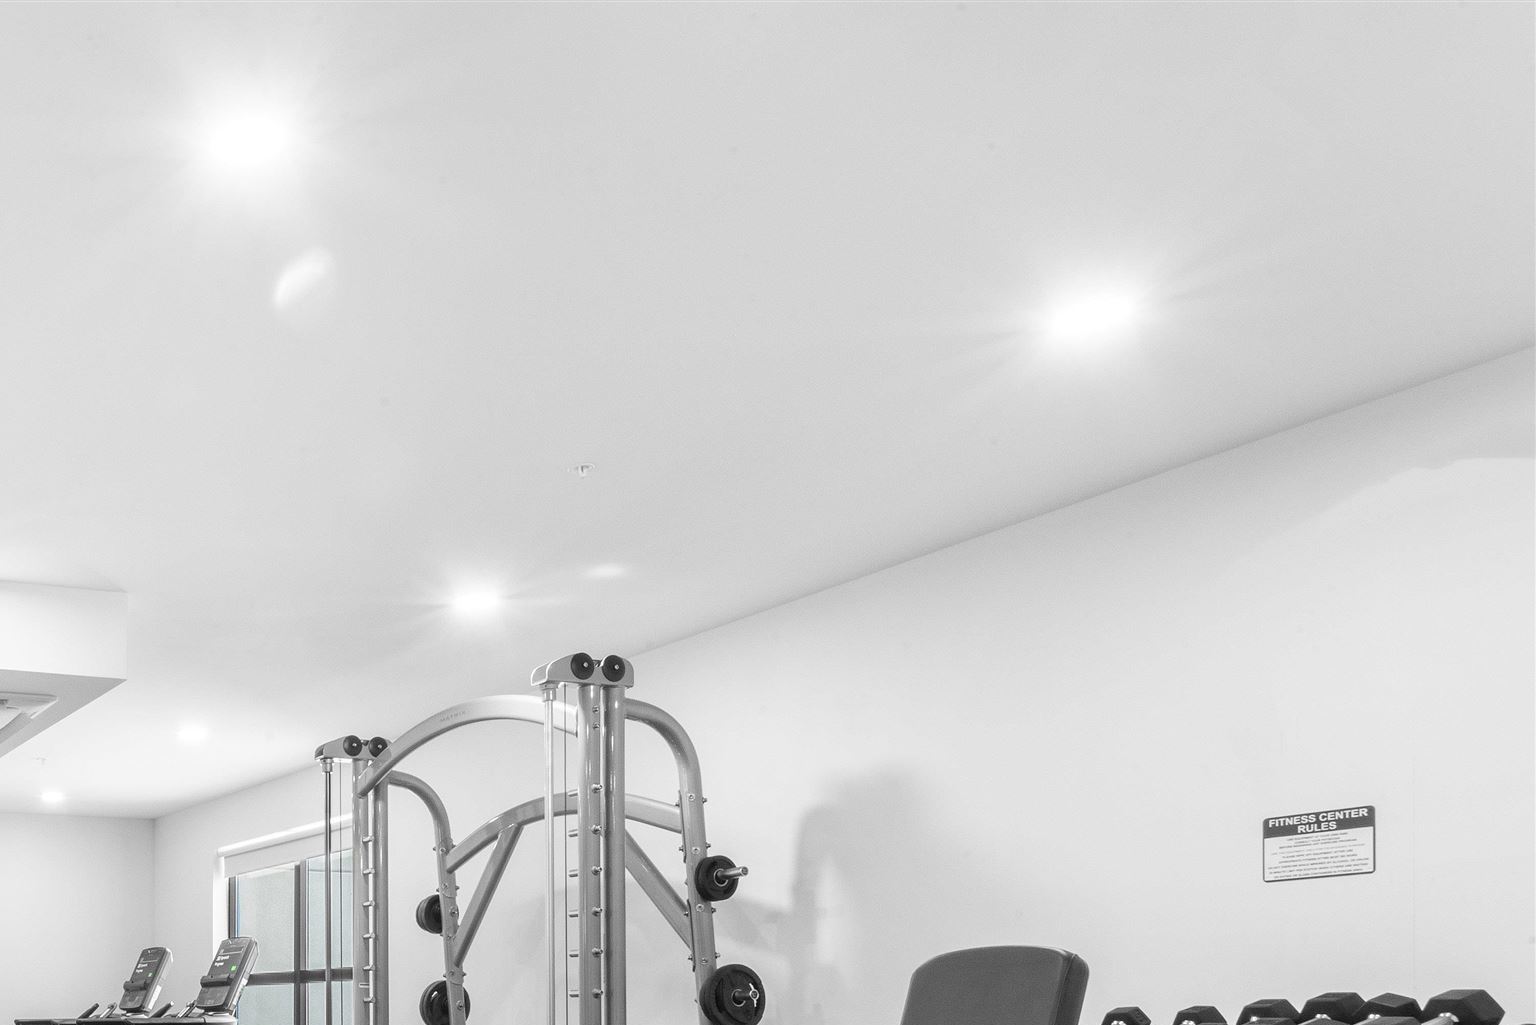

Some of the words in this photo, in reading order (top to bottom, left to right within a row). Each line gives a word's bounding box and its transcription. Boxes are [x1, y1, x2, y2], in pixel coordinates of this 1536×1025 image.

[1268, 814, 1316, 828] FITNESS
[1318, 807, 1368, 822] CENTER
[1297, 821, 1337, 834] RULES
